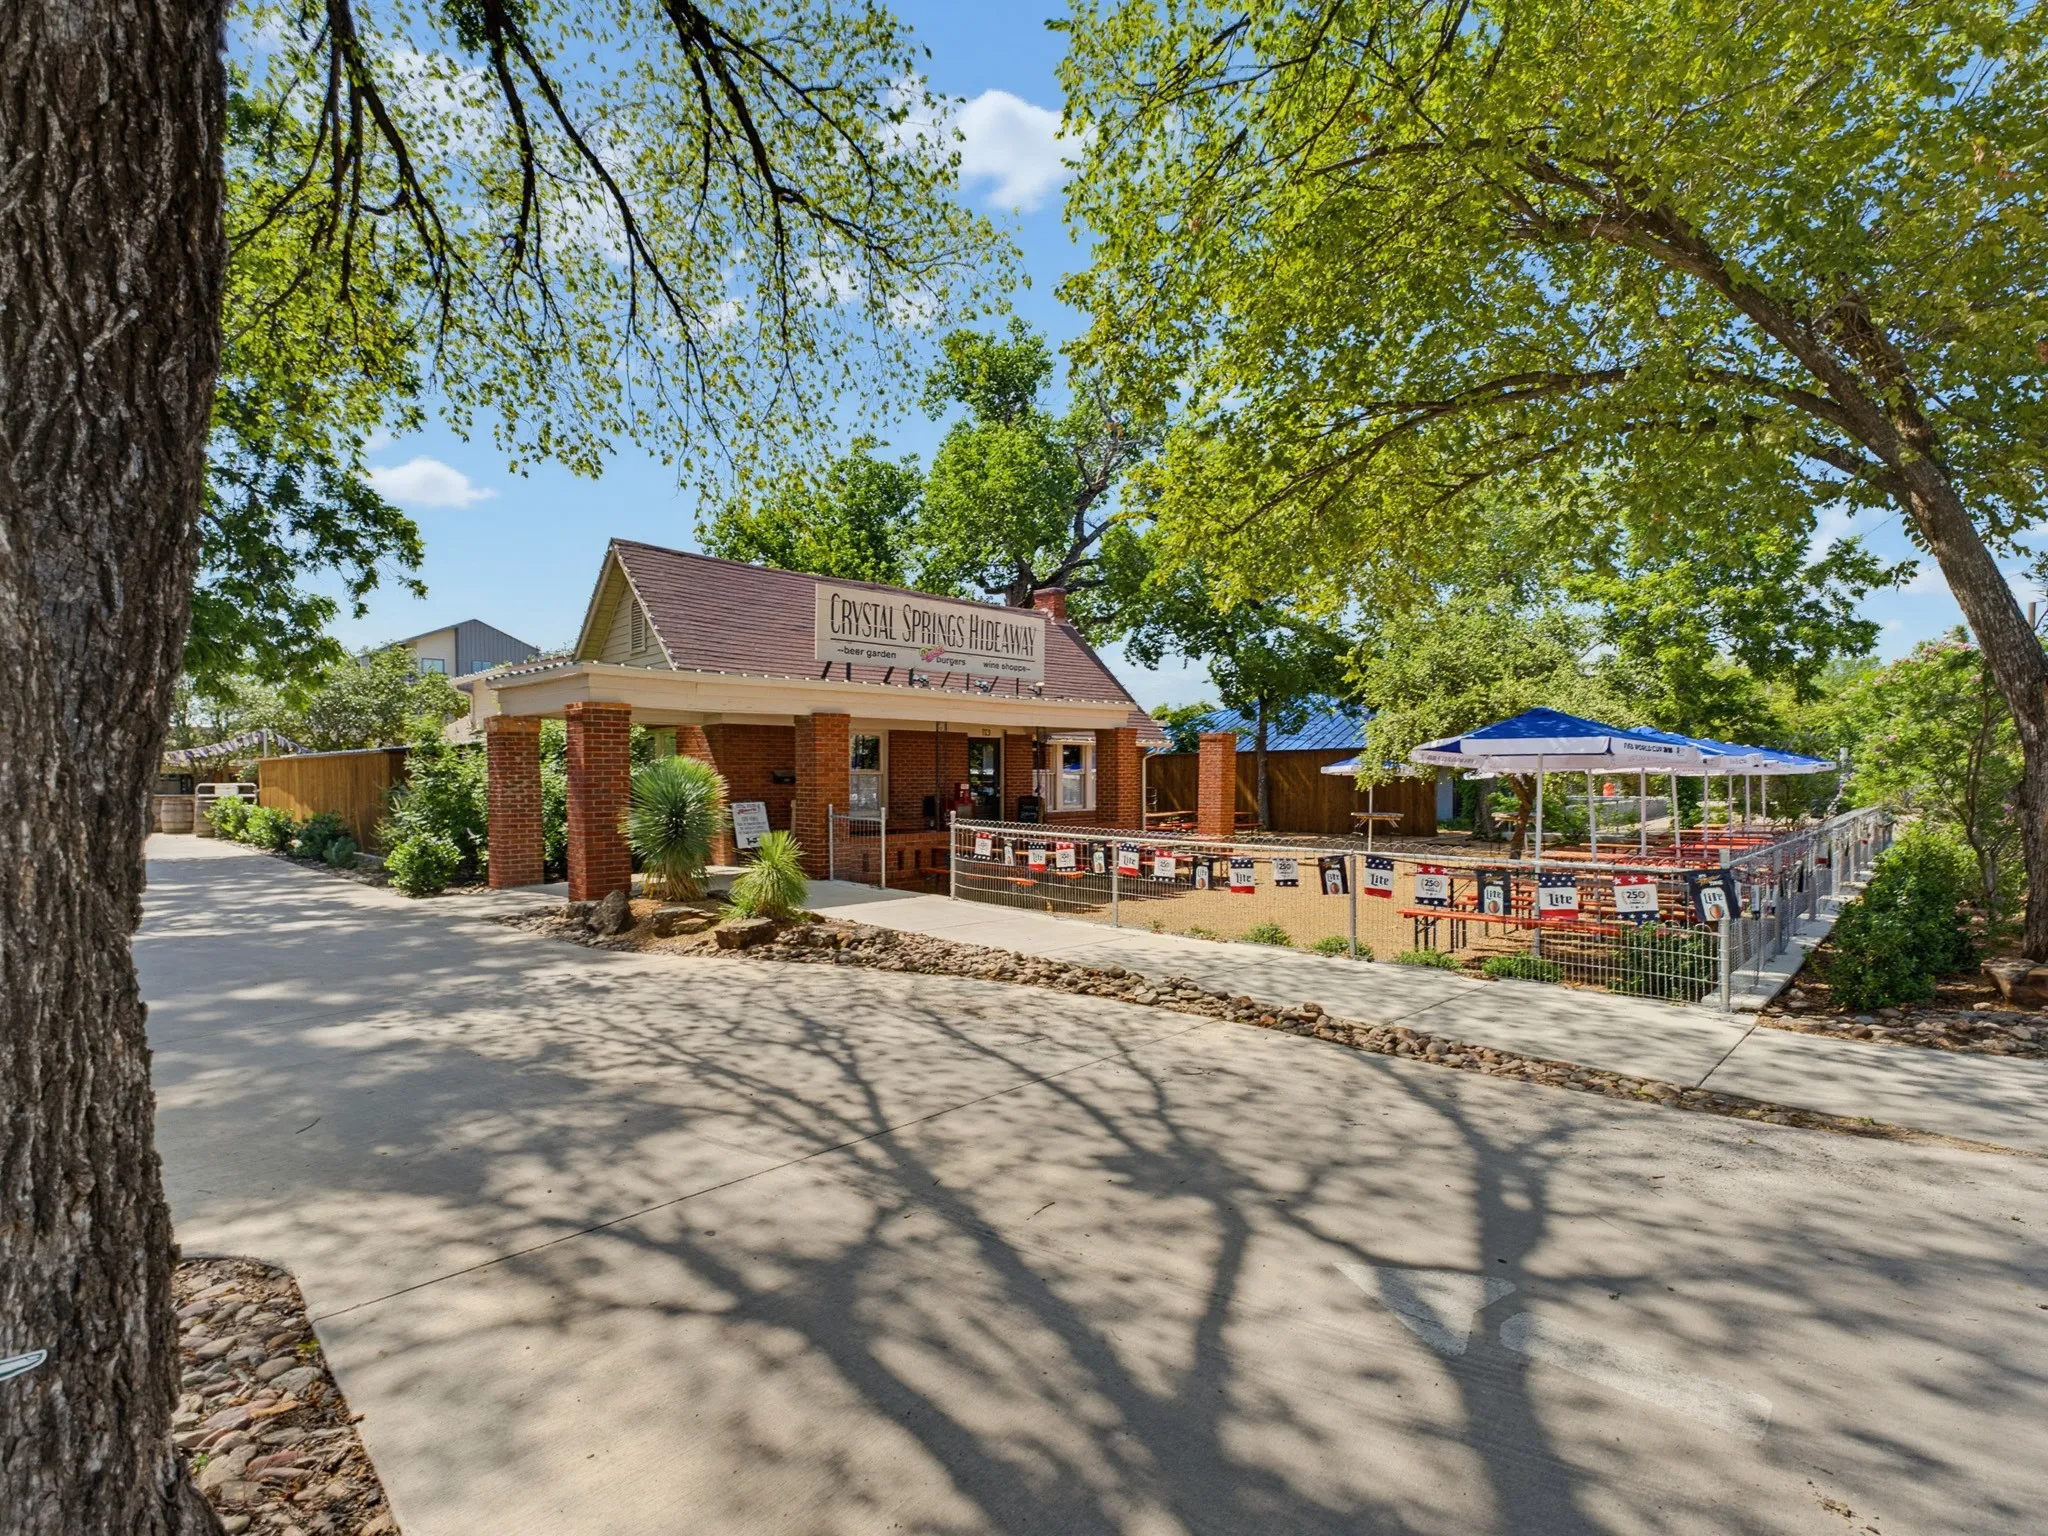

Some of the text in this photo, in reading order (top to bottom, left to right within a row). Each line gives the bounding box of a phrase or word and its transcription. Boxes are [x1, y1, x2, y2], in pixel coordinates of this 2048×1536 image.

[830, 592, 1037, 657] CRYSTAL SPRINGS HIDEAWAY
[866, 649, 897, 659] garden
[936, 655, 967, 667] burgers
[983, 660, 1000, 670] wine
[1123, 855, 1136, 866] Lite
[1234, 872, 1252, 884] Lite
[1369, 873, 1390, 887] Lite
[1424, 879, 1440, 887] 250
[1485, 889, 1502, 900] Lite
[1548, 891, 1573, 907] Lite
[1626, 890, 1646, 899] 250
[1703, 892, 1723, 904] Lite
